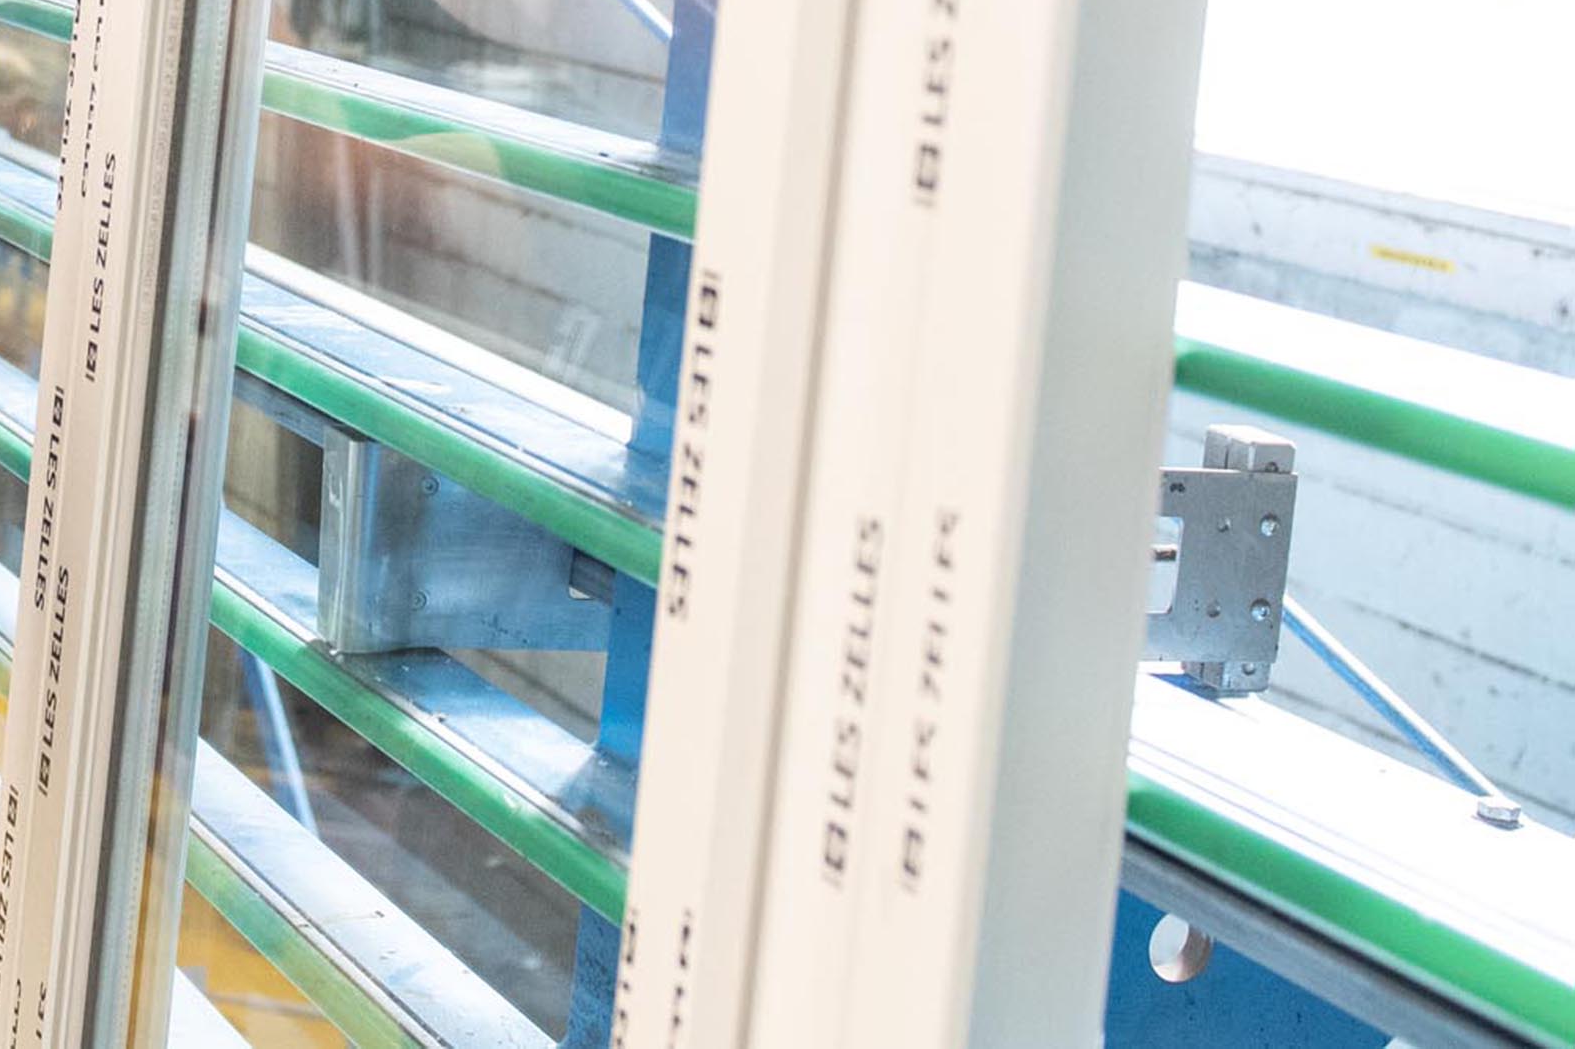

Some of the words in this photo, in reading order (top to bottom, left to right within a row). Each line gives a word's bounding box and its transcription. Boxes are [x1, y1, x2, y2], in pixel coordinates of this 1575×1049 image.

[921, 37, 951, 127] LES
[95, 152, 116, 270] ZELLES
[89, 278, 104, 334] LES
[687, 343, 715, 427] LES
[46, 434, 60, 490] LES
[34, 498, 54, 612] ZELLES
[665, 444, 705, 623] ZELLES
[48, 565, 69, 685] ZELLES
[839, 514, 885, 705] ZELLES
[41, 689, 58, 750] LES
[829, 719, 862, 814] LES
[0, 831, 16, 889] LES
